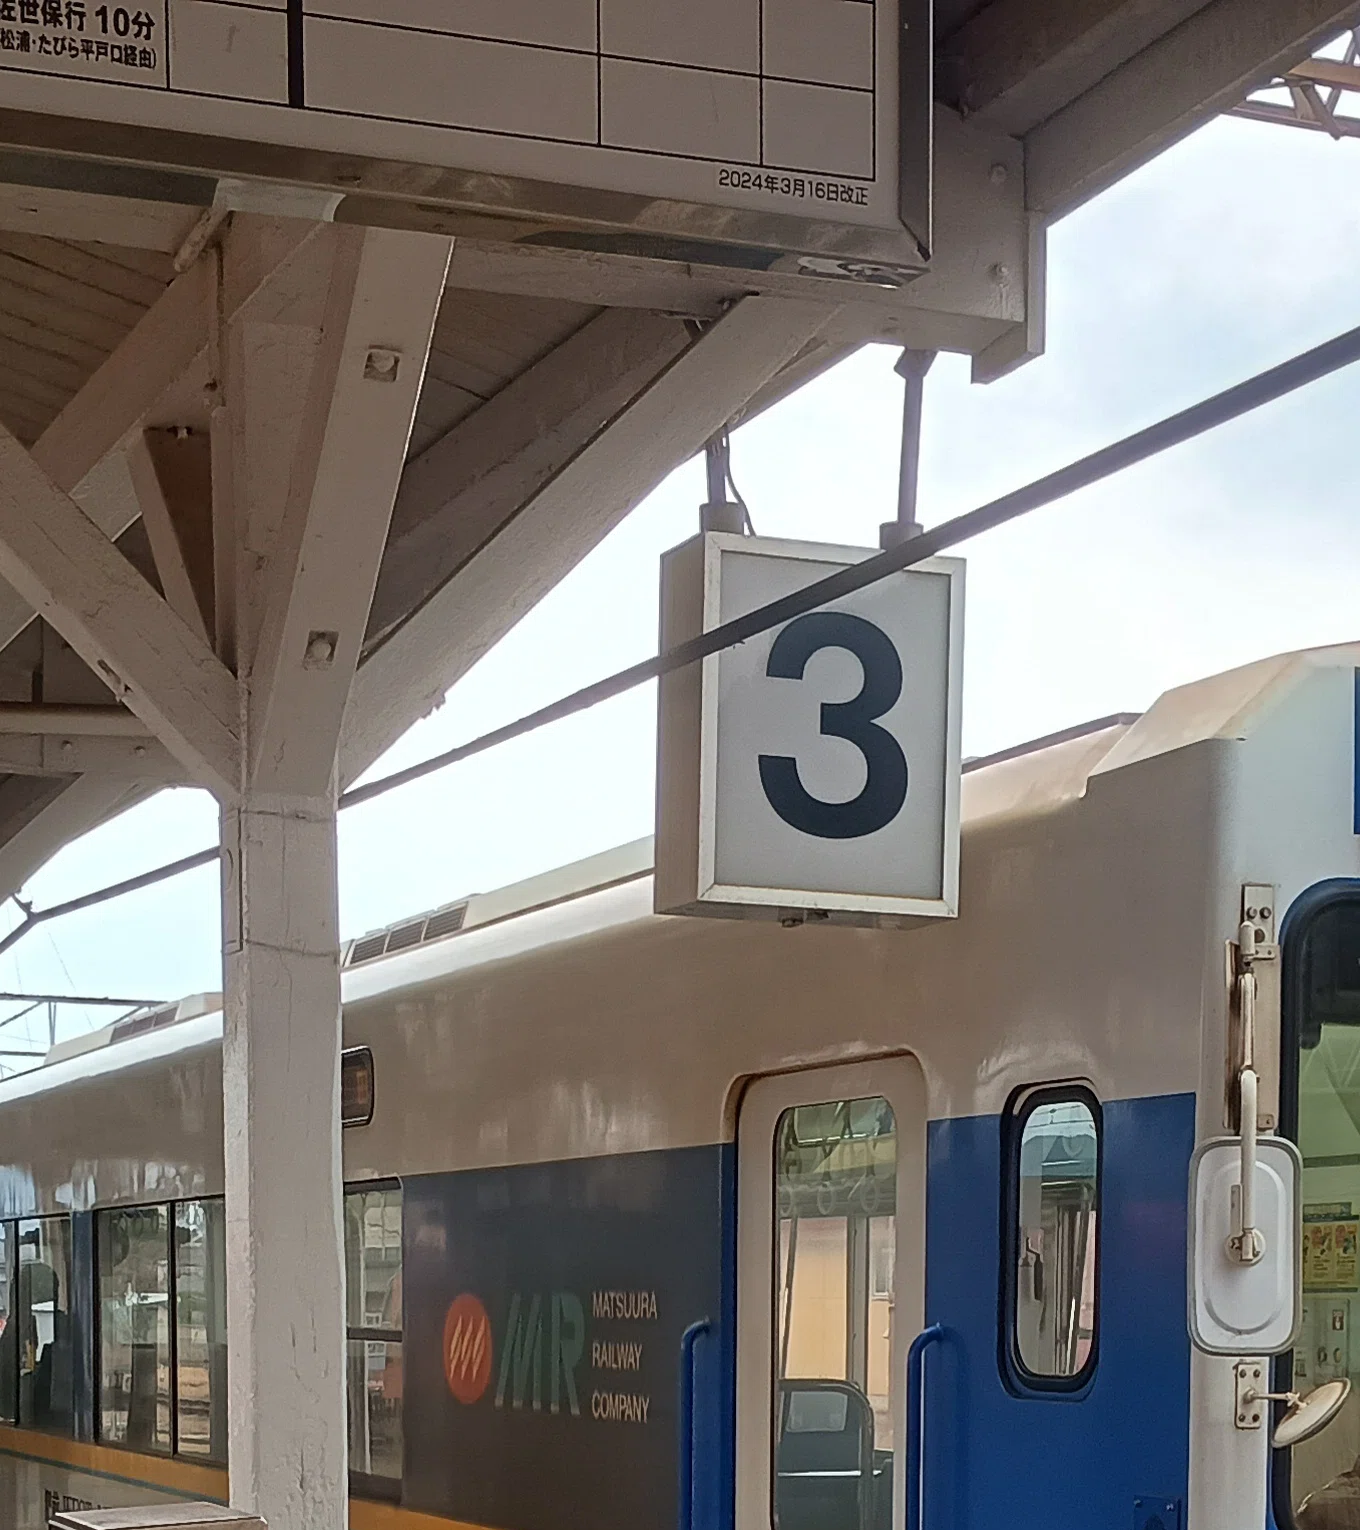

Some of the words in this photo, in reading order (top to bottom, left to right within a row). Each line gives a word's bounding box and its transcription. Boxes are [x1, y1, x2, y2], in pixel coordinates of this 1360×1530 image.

[95, 5, 155, 40] 10分
[718, 168, 869, 206] 2024年3月16日改正
[758, 611, 908, 839] 3
[593, 1291, 658, 1320] MATSUURA
[592, 1341, 643, 1371] RAILWAY
[591, 1391, 650, 1424] COMPANY
